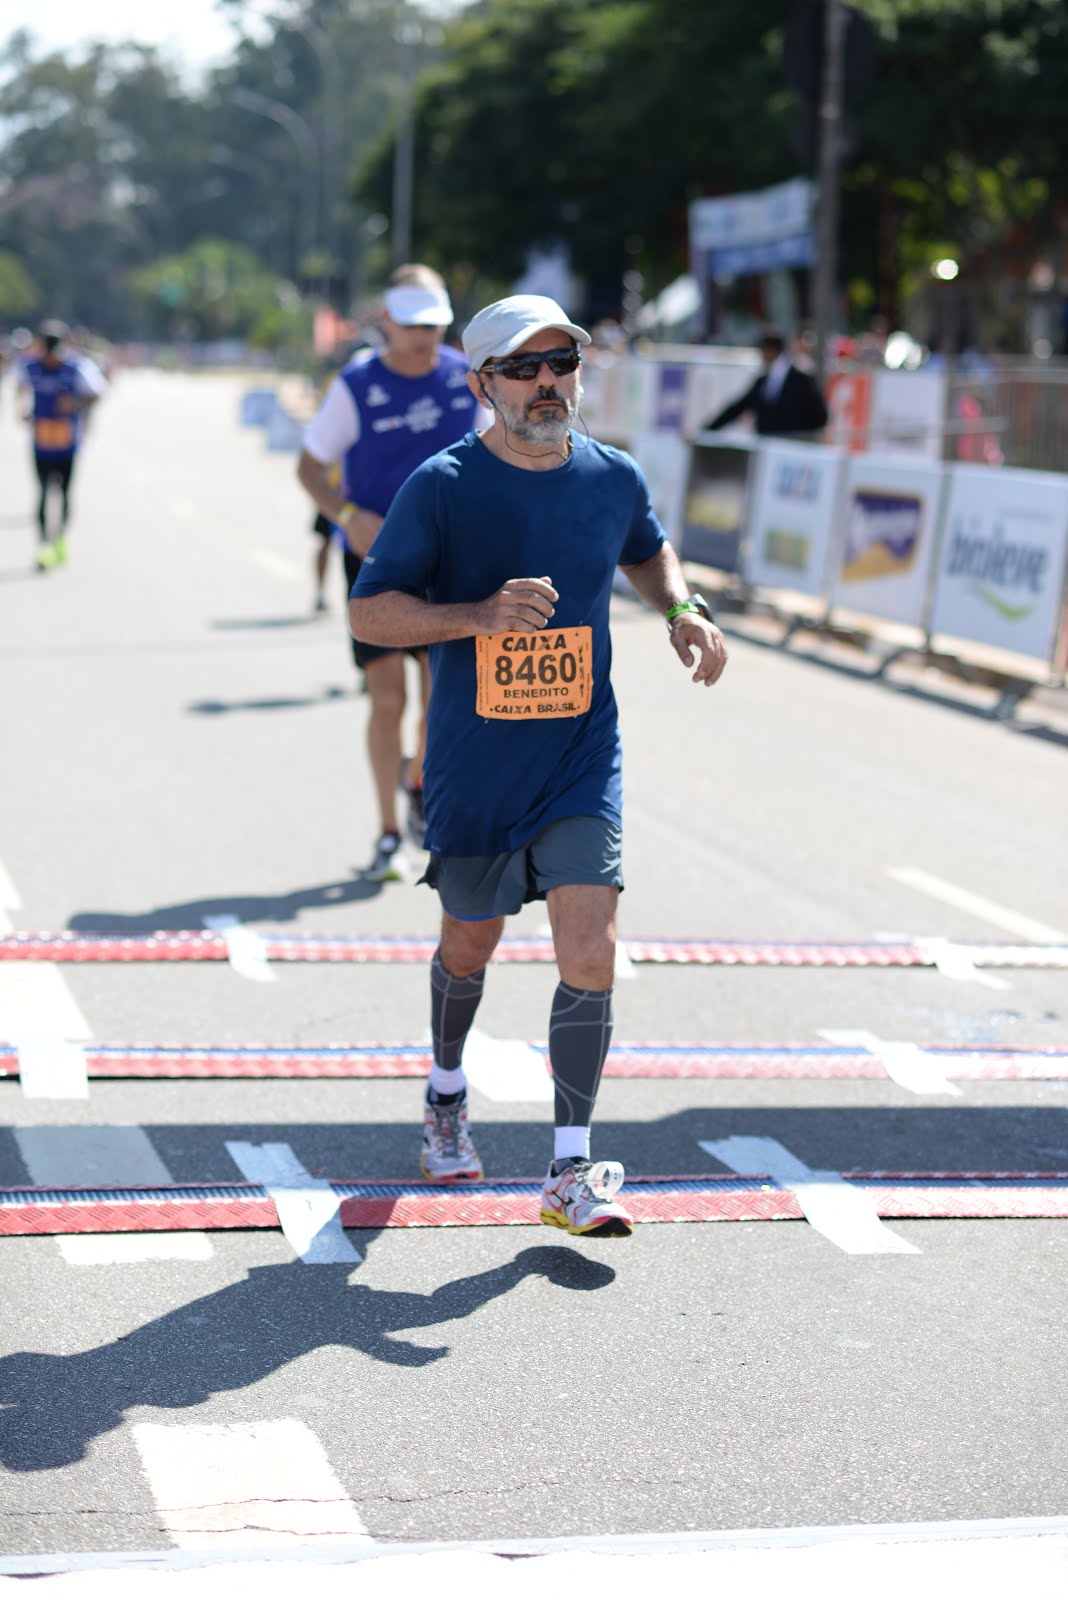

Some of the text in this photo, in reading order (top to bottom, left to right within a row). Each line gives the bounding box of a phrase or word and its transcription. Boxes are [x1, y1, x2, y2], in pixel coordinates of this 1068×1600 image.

[502, 634, 566, 652] CAIXA
[495, 652, 577, 686] 8460
[503, 687, 569, 699] BENEDITO
[494, 705, 532, 714] CAIXA
